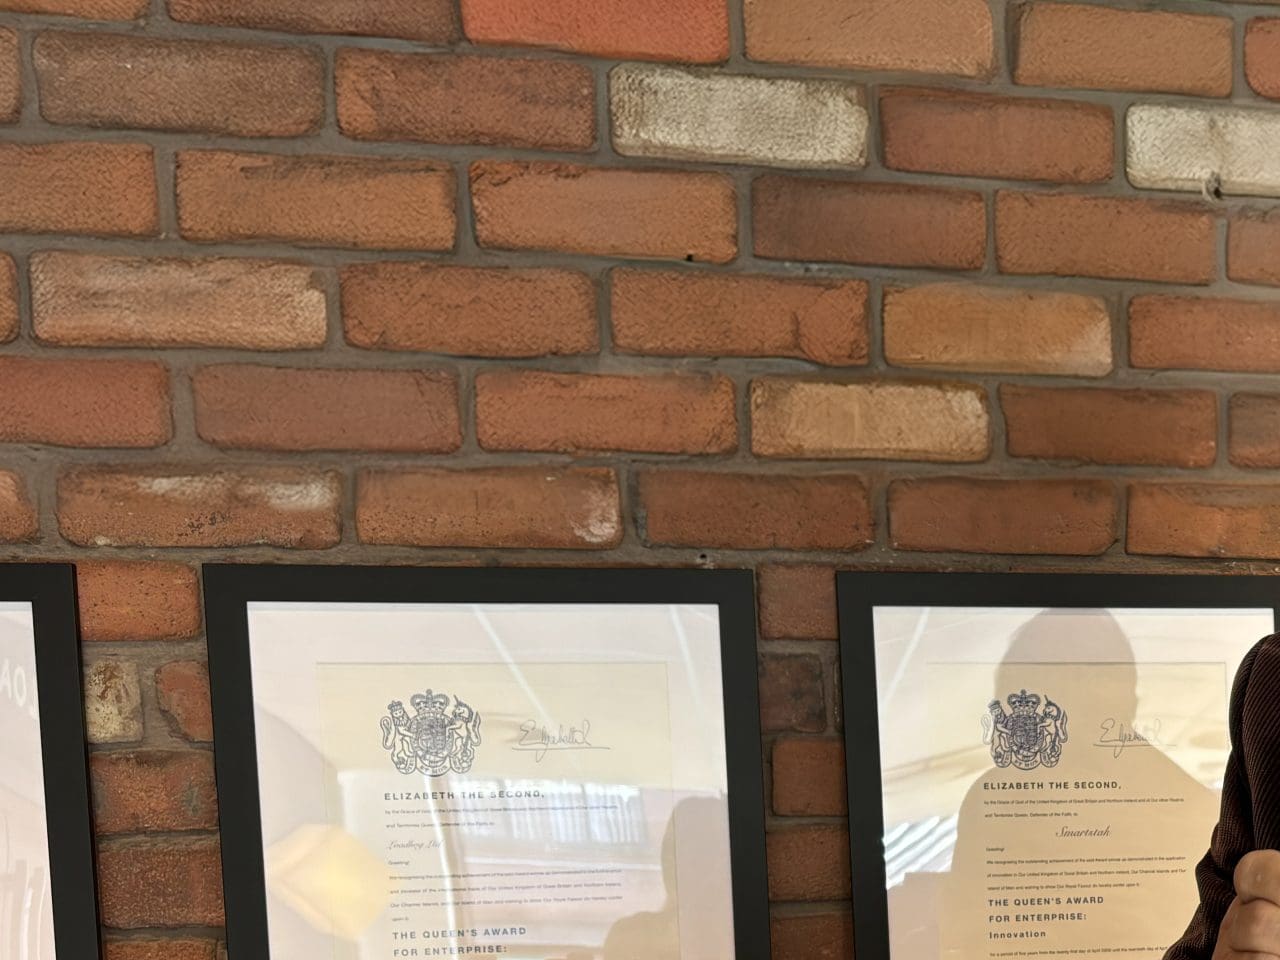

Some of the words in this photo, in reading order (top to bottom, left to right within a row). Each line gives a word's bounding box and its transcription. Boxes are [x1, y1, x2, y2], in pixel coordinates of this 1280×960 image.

[983, 782, 1044, 790] ELIZABETH
[1074, 781, 1122, 790] SECOND,
[384, 791, 455, 801] ELIZABETH
[461, 791, 484, 799] THE
[988, 899, 1009, 907] THE
[1014, 897, 1062, 906] QUEEN'S
[1066, 896, 1104, 904] AWARD
[989, 915, 1010, 923] FOR
[1015, 913, 1087, 922] ENTERPRISE:
[392, 931, 417, 940] THE
[422, 928, 478, 939] QUEEN'S
[483, 927, 527, 936] AWARD
[989, 930, 1046, 939] Innovation
[393, 948, 418, 957] FOR
[424, 945, 507, 956] ENTERPRISE:
